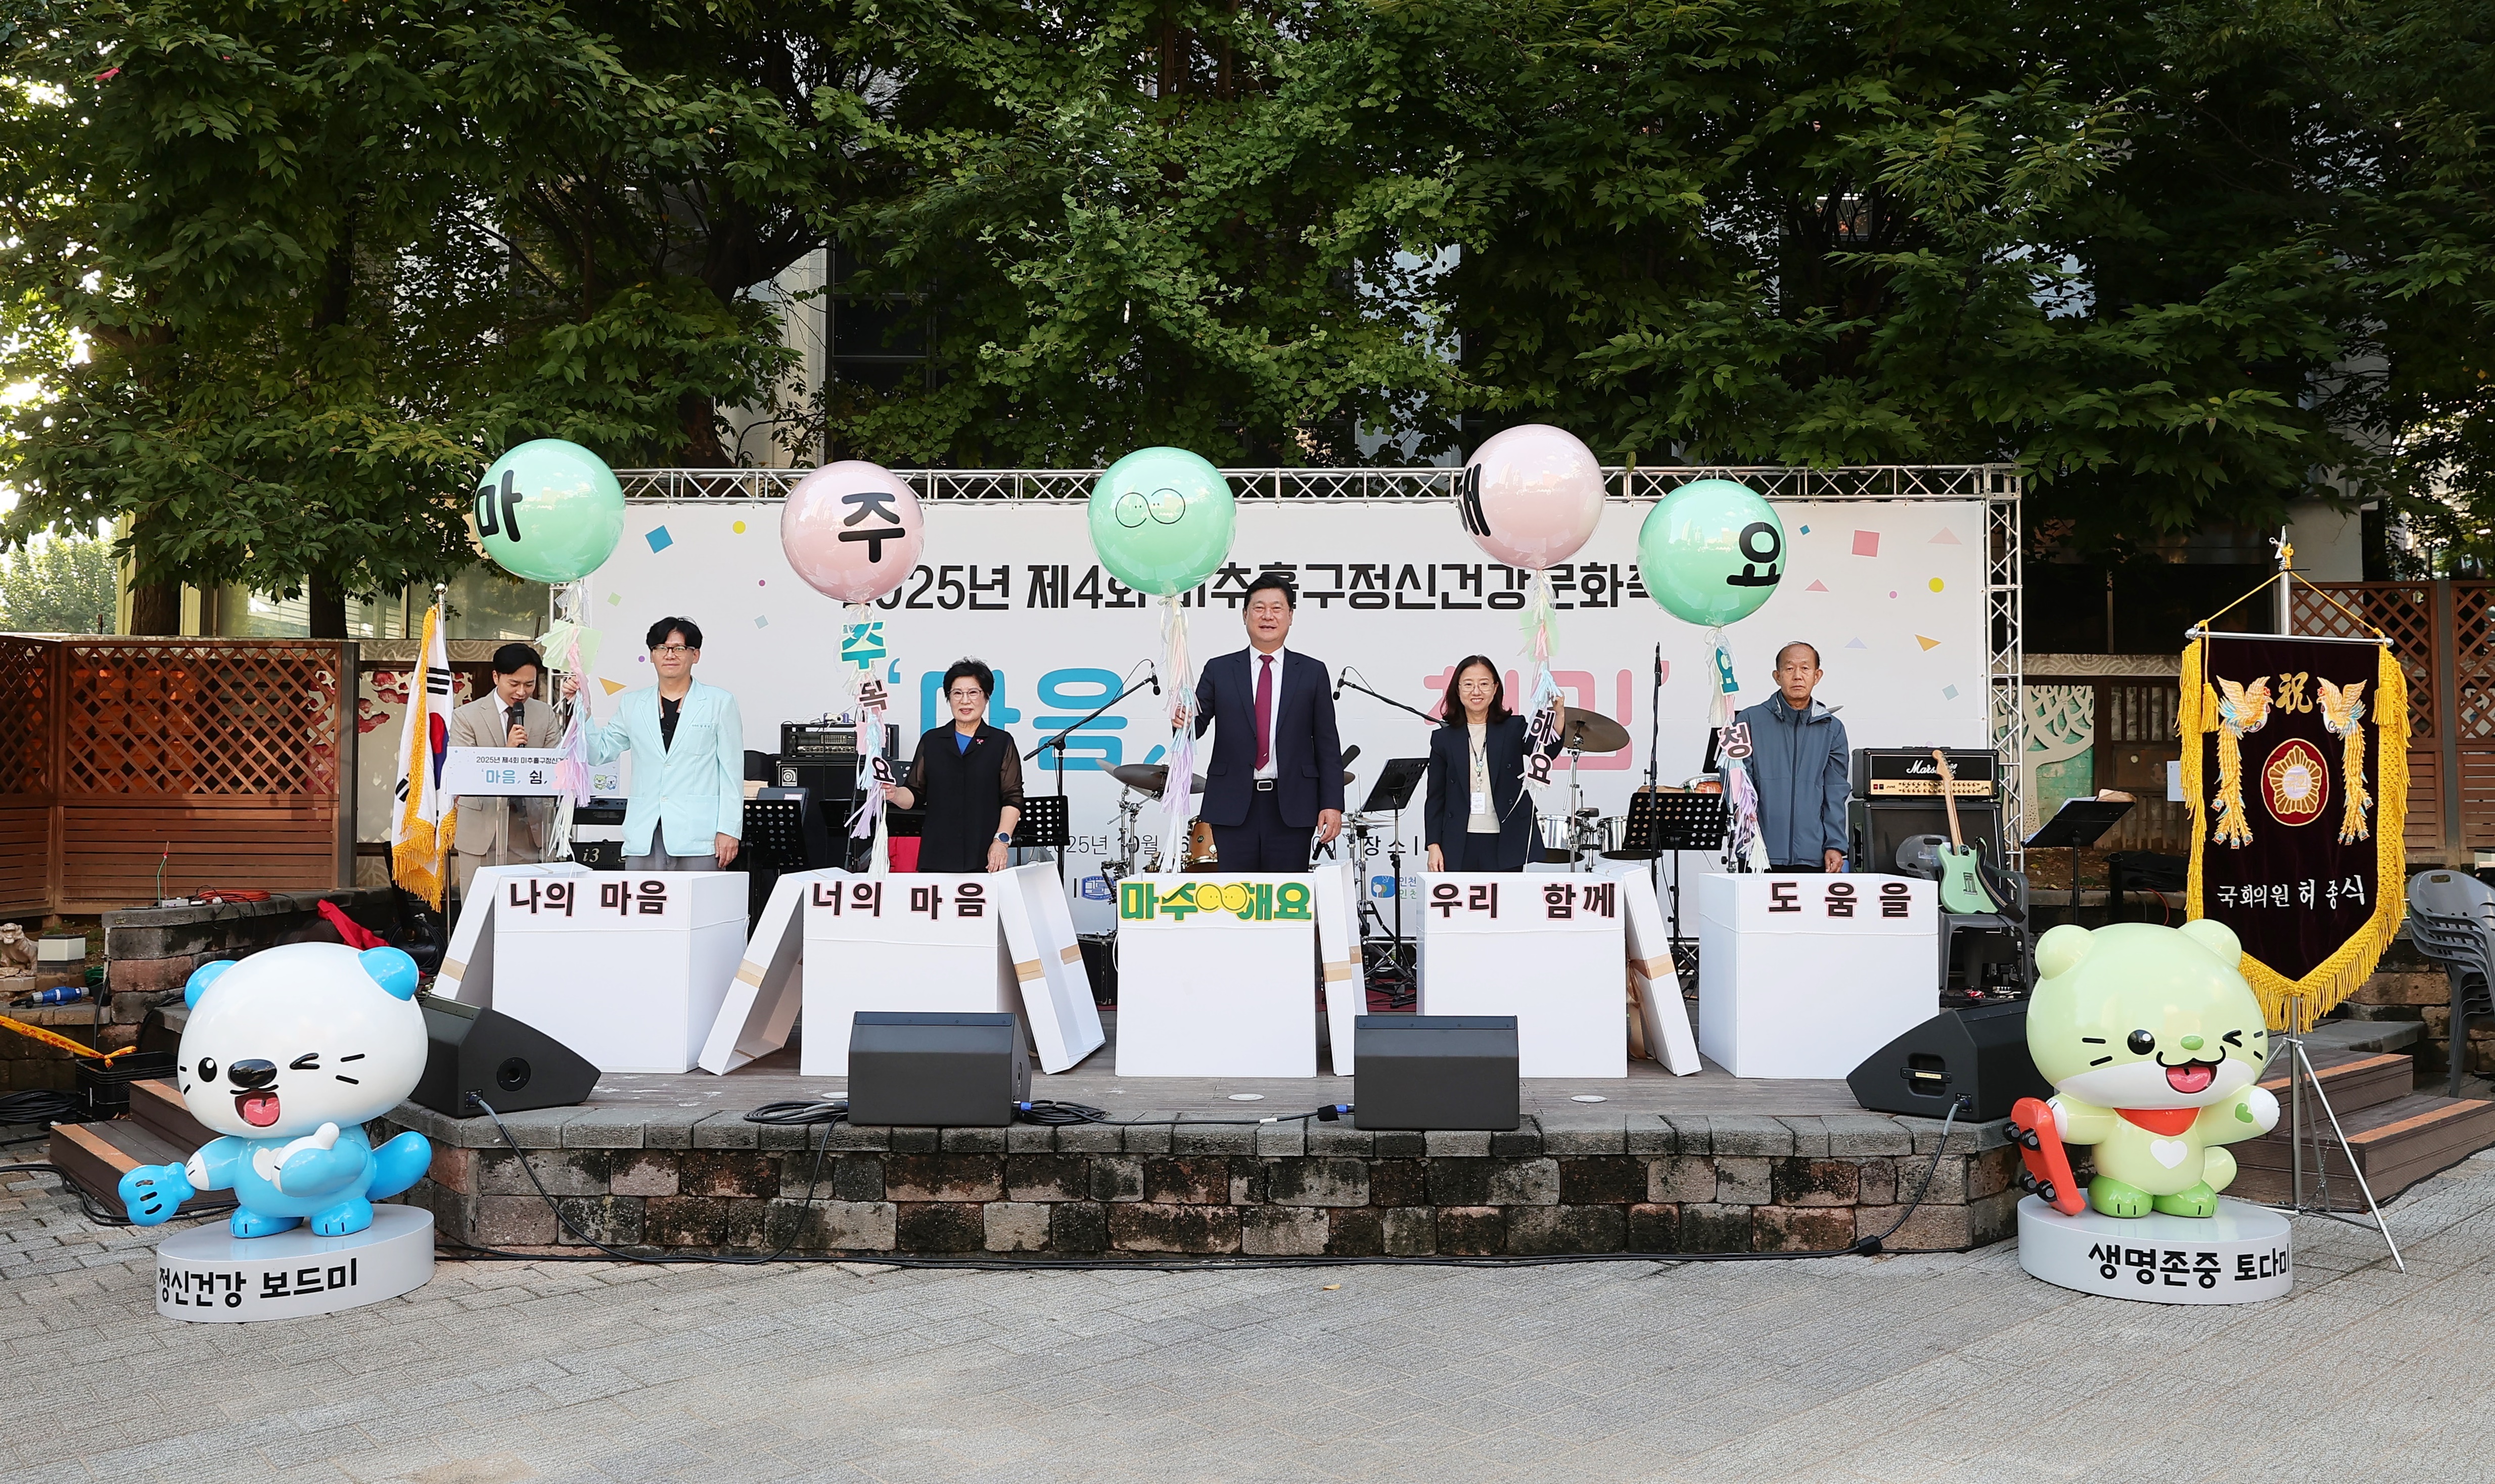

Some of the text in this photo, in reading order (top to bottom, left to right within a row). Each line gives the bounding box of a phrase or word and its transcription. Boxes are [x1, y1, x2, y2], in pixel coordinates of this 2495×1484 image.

[475, 470, 523, 542] 마
[838, 492, 905, 563] 주
[1726, 522, 1780, 586] 요
[843, 565, 1009, 610] 25년
[842, 621, 887, 670] 주
[2275, 671, 2313, 714] 祝
[1719, 724, 1750, 758] 청
[582, 848, 600, 862] i3
[1046, 835, 1107, 855] 25년
[1118, 835, 1158, 855] 0월
[511, 879, 667, 917] 나의 마음
[812, 881, 986, 919] 너의 마음
[1430, 883, 1615, 919] 우리 함께
[1768, 882, 1912, 918] 도움을
[2217, 884, 2289, 908] 국회의원
[159, 1258, 357, 1308] 정신건강 보드미
[2088, 1242, 2290, 1289] 생명존중 토다미
